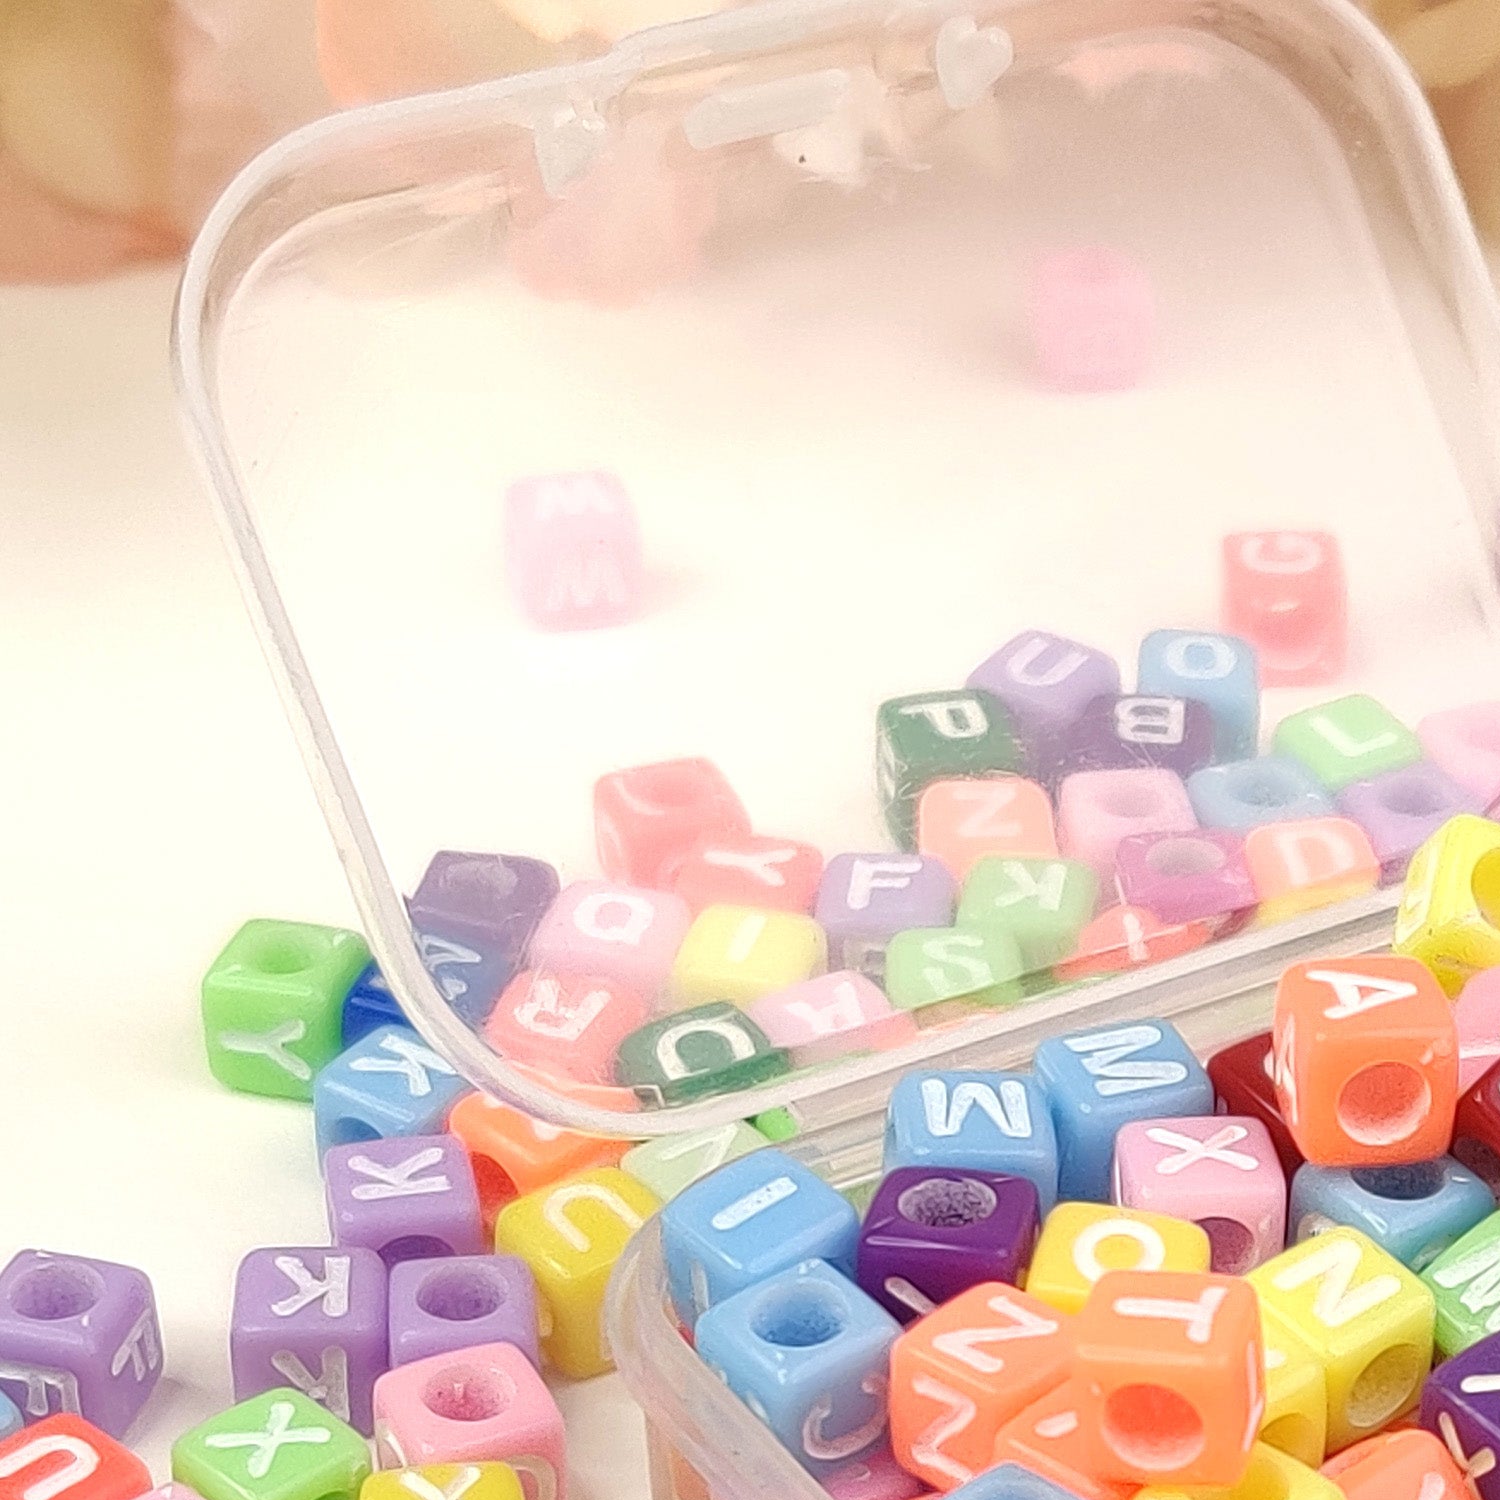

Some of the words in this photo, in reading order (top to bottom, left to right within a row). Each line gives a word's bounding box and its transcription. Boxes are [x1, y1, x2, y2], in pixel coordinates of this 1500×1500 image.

[1007, 636, 1090, 687] U
[898, 700, 988, 738] P
[1114, 698, 1189, 744] B
[1309, 715, 1398, 758] L
[704, 847, 797, 887] Y
[850, 860, 923, 910] F
[995, 860, 1068, 912] K
[573, 892, 655, 946] Q
[725, 913, 767, 963] I
[514, 979, 612, 1041] R
[1306, 969, 1418, 1019] A
[220, 1018, 313, 1082] Y
[348, 1147, 452, 1201] K
[1145, 1124, 1259, 1176] X
[712, 1176, 798, 1231] I
[271, 1254, 351, 1318] K
[1114, 1286, 1229, 1343] T
[205, 1402, 332, 1479] X
